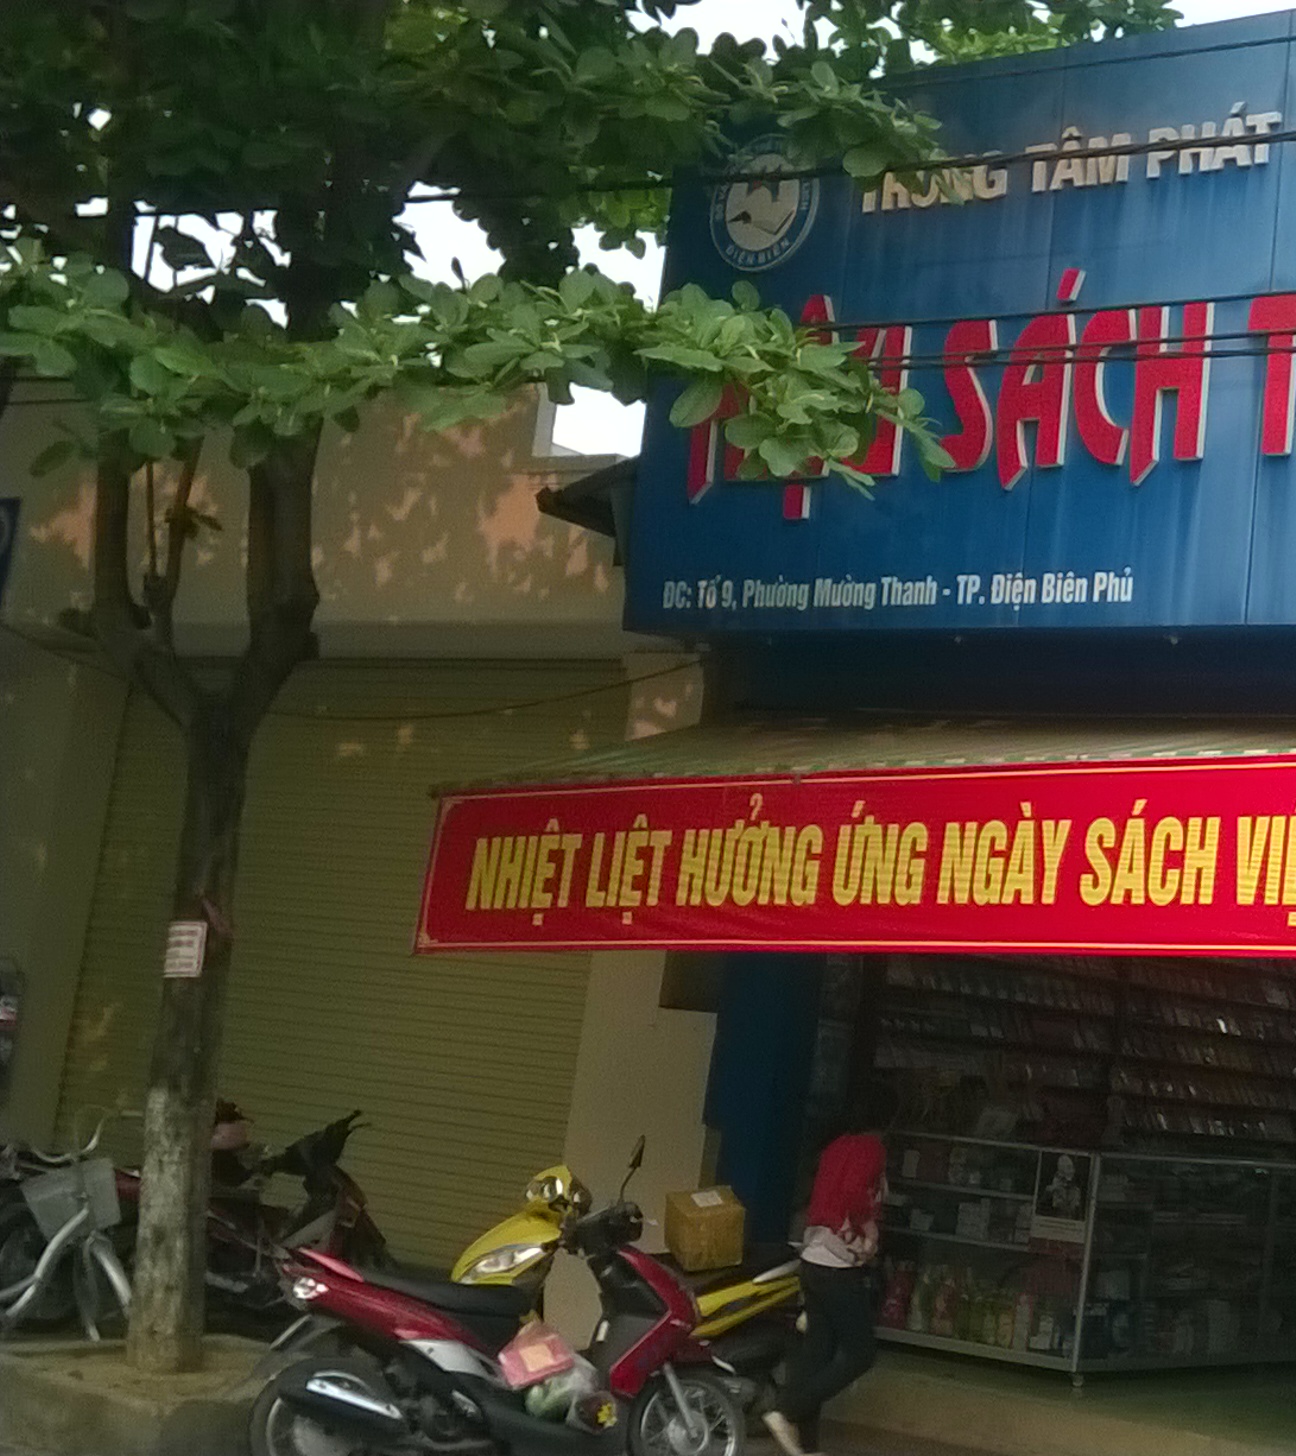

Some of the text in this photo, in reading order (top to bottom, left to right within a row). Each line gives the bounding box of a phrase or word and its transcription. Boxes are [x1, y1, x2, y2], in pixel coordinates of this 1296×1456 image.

[1025, 128, 1130, 193] TÂM
[1146, 103, 1282, 179] PHÁT
[941, 268, 1215, 490] SÁCH
[663, 580, 692, 610] ĐC:
[813, 574, 877, 611] Mường
[880, 575, 937, 606] Thanh
[956, 574, 985, 604] TP.
[990, 572, 1036, 611] Điện
[1041, 570, 1087, 604] Biên
[1092, 566, 1135, 603] Phủ
[465, 818, 583, 927] NHIỆT
[585, 813, 674, 925] LIỆT
[676, 793, 824, 908] HƯỞNG
[832, 800, 929, 907] ỨNG
[936, 801, 1074, 907] NGÀY
[1079, 799, 1220, 908] SÁCH
